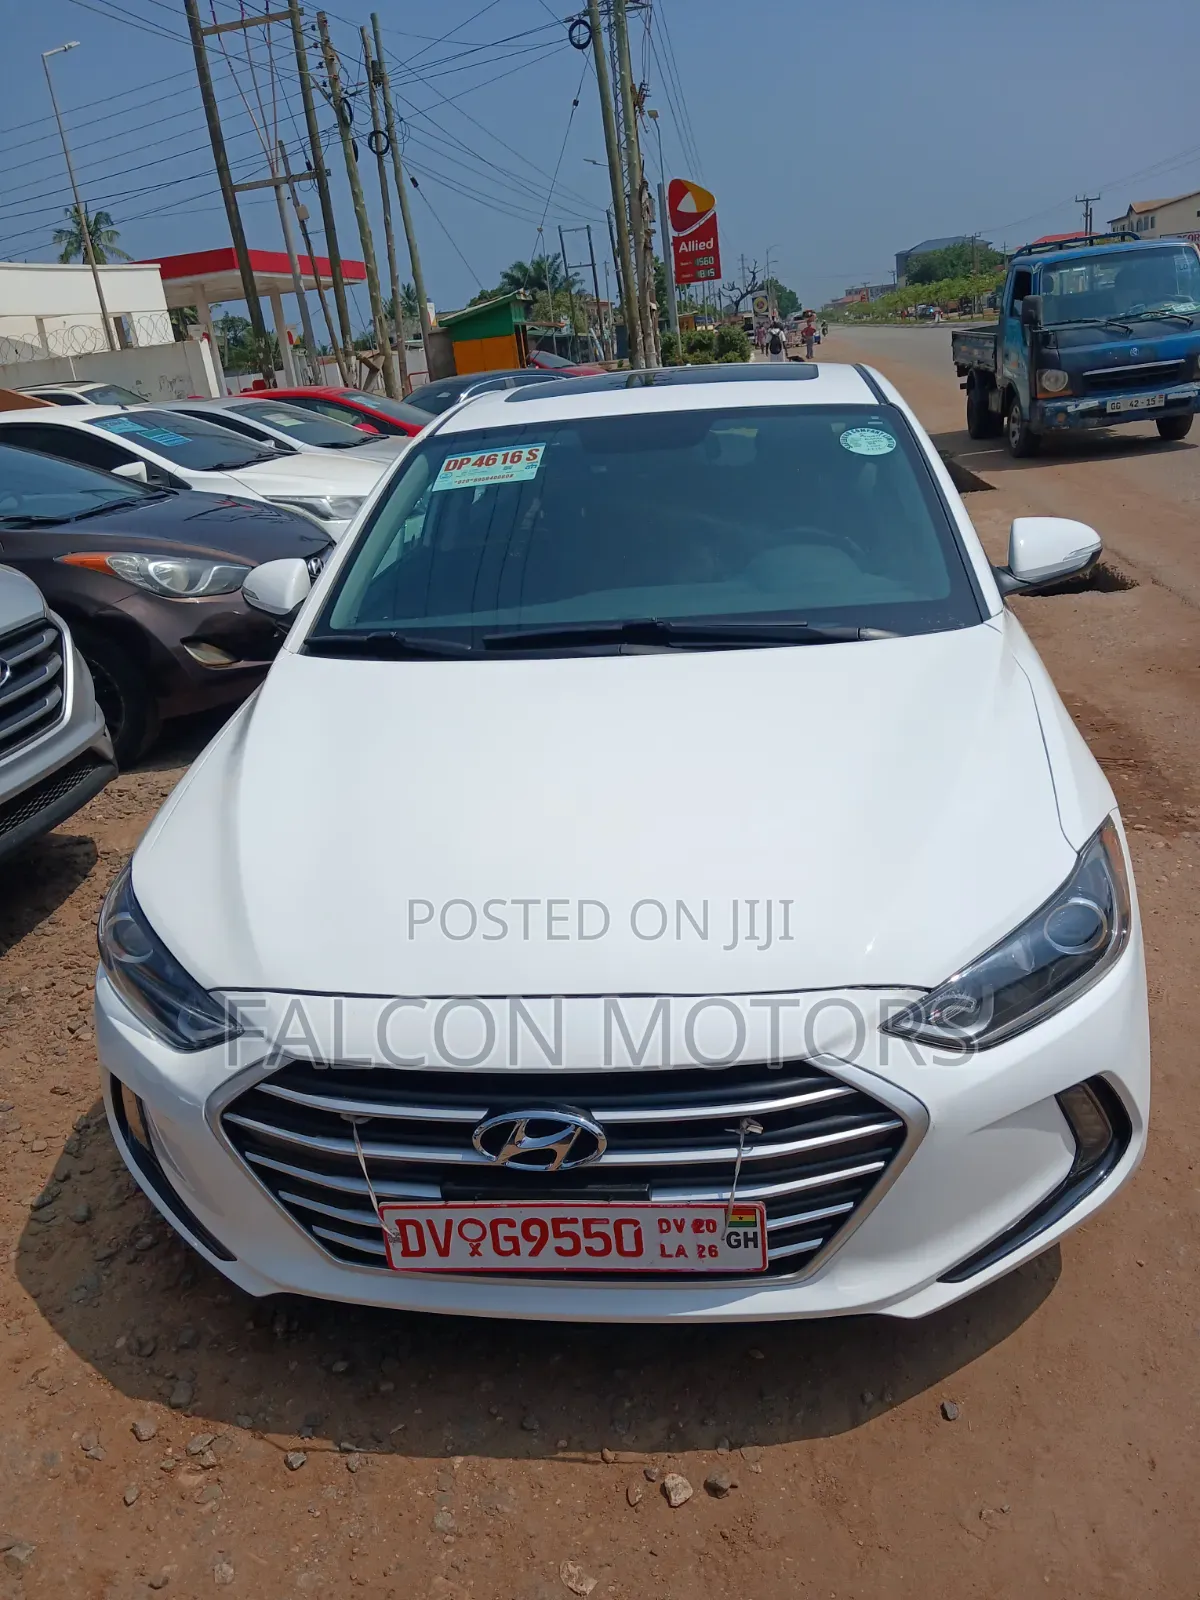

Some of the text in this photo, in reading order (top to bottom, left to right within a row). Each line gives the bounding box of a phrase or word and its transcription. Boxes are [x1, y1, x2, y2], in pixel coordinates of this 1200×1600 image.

[679, 238, 714, 253] Allied
[444, 457, 472, 471] DP
[525, 448, 540, 462] S
[657, 1218, 686, 1234] DV
[726, 1231, 759, 1249] GH
[659, 1243, 719, 1259] LA 26
